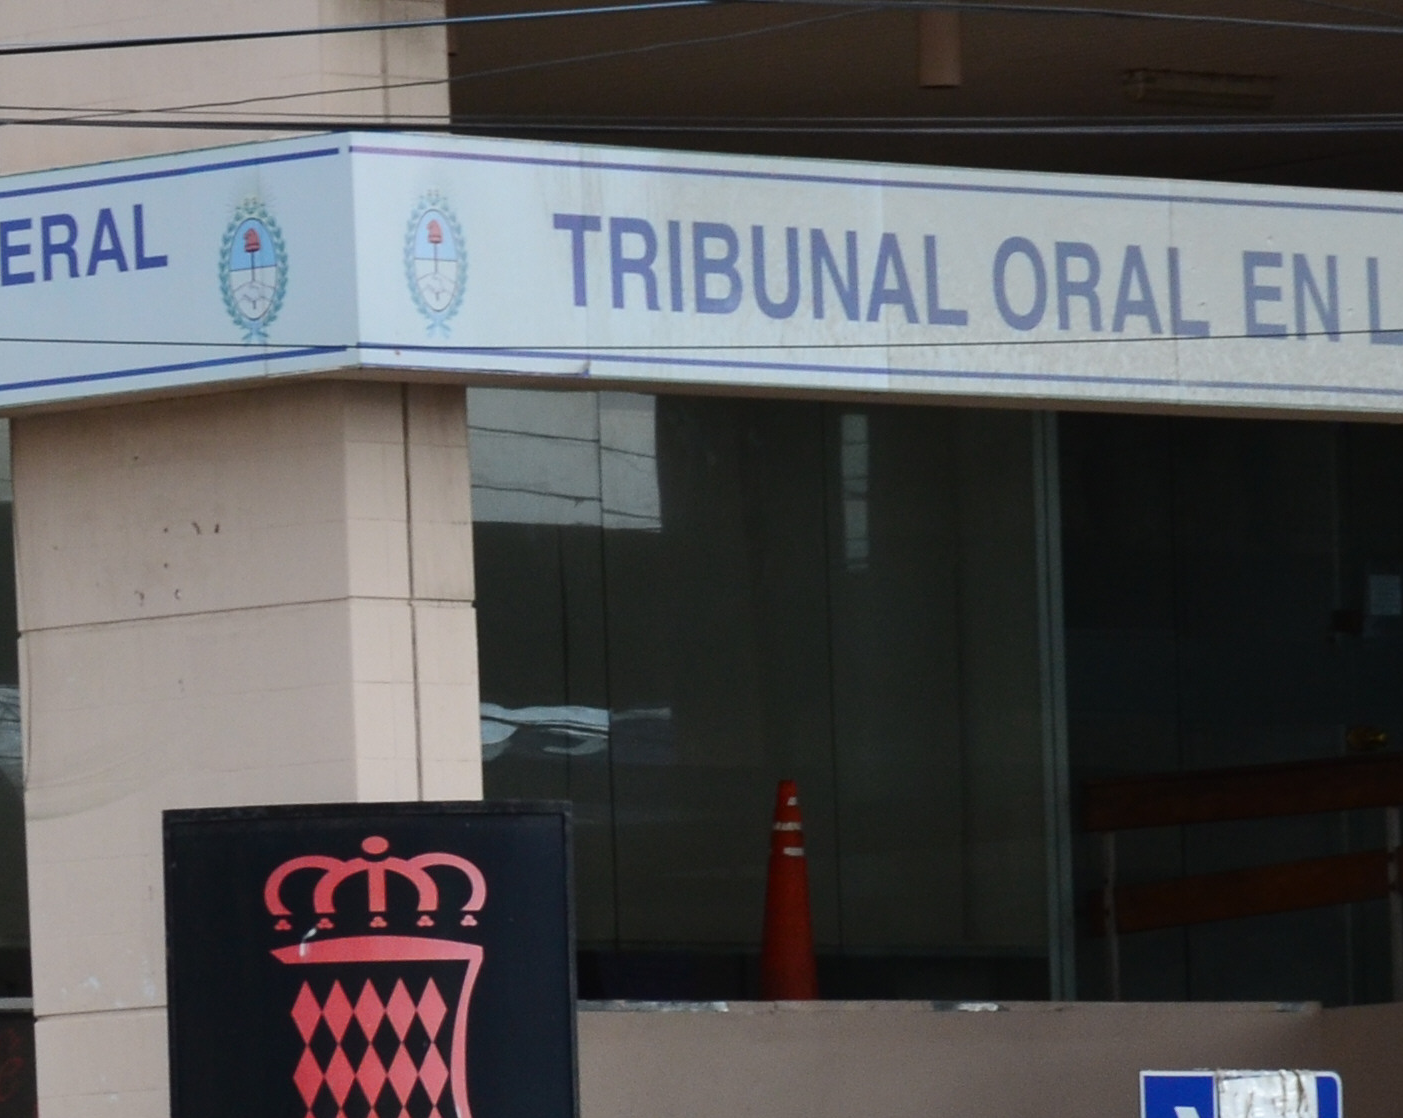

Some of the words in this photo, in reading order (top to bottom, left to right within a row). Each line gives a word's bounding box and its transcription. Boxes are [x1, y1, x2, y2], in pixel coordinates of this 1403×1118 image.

[551, 213, 969, 327] TRIBUNAL
[993, 236, 1211, 340] ORAL
[1242, 250, 1339, 343] EN
